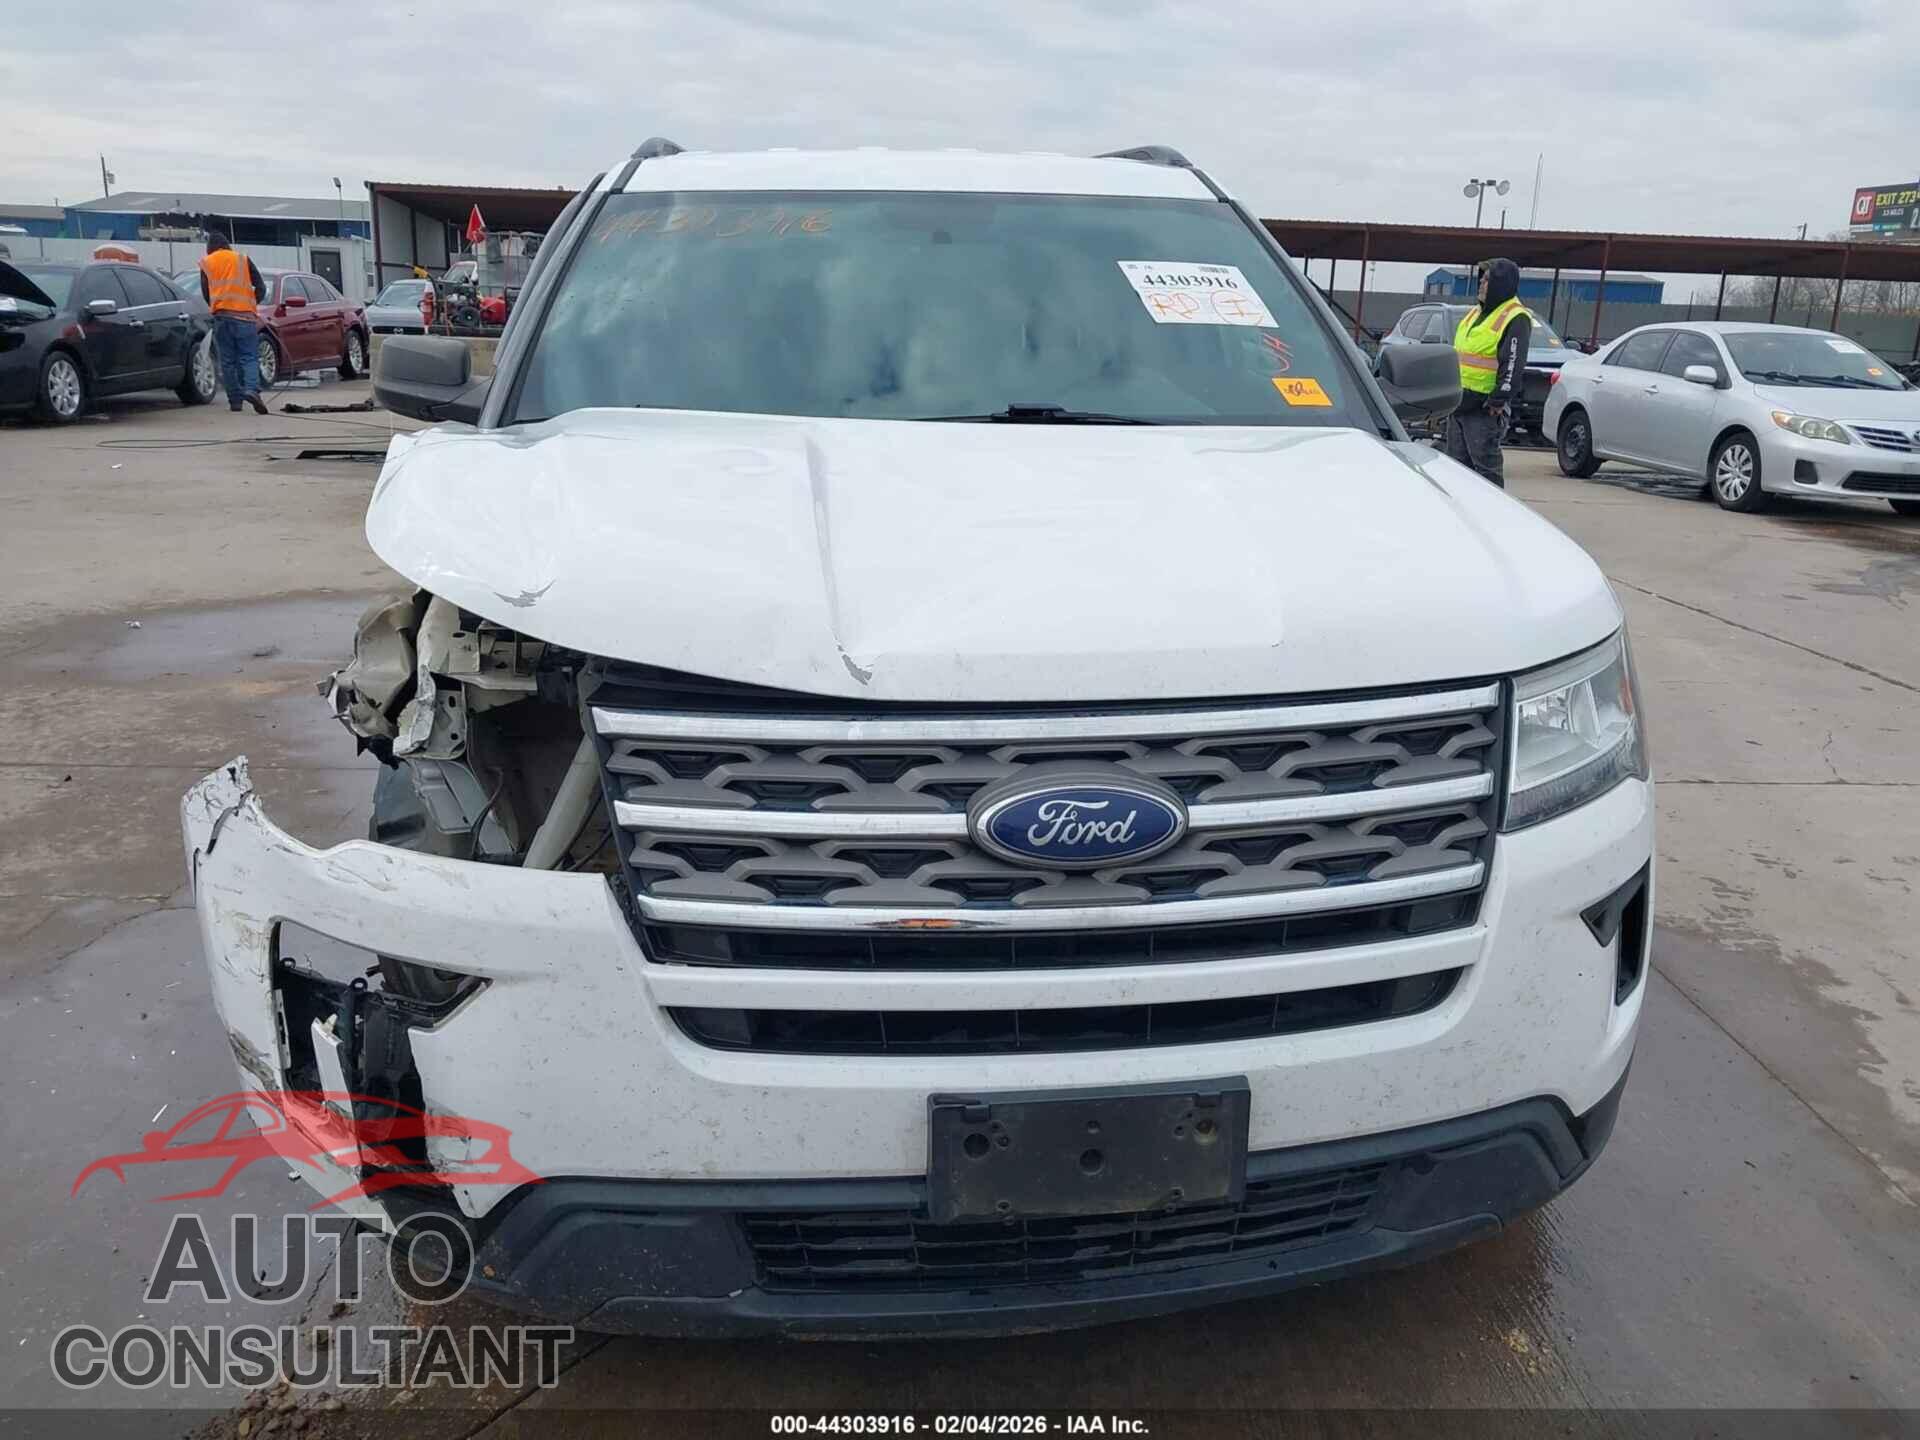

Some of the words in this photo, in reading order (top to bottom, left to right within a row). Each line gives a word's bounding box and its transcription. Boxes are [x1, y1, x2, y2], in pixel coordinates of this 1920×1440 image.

[1875, 192, 1897, 206] EXIT
[1898, 190, 1920, 205] 273
[1143, 273, 1239, 289] 44303916
[1027, 799, 1137, 847] Ford
